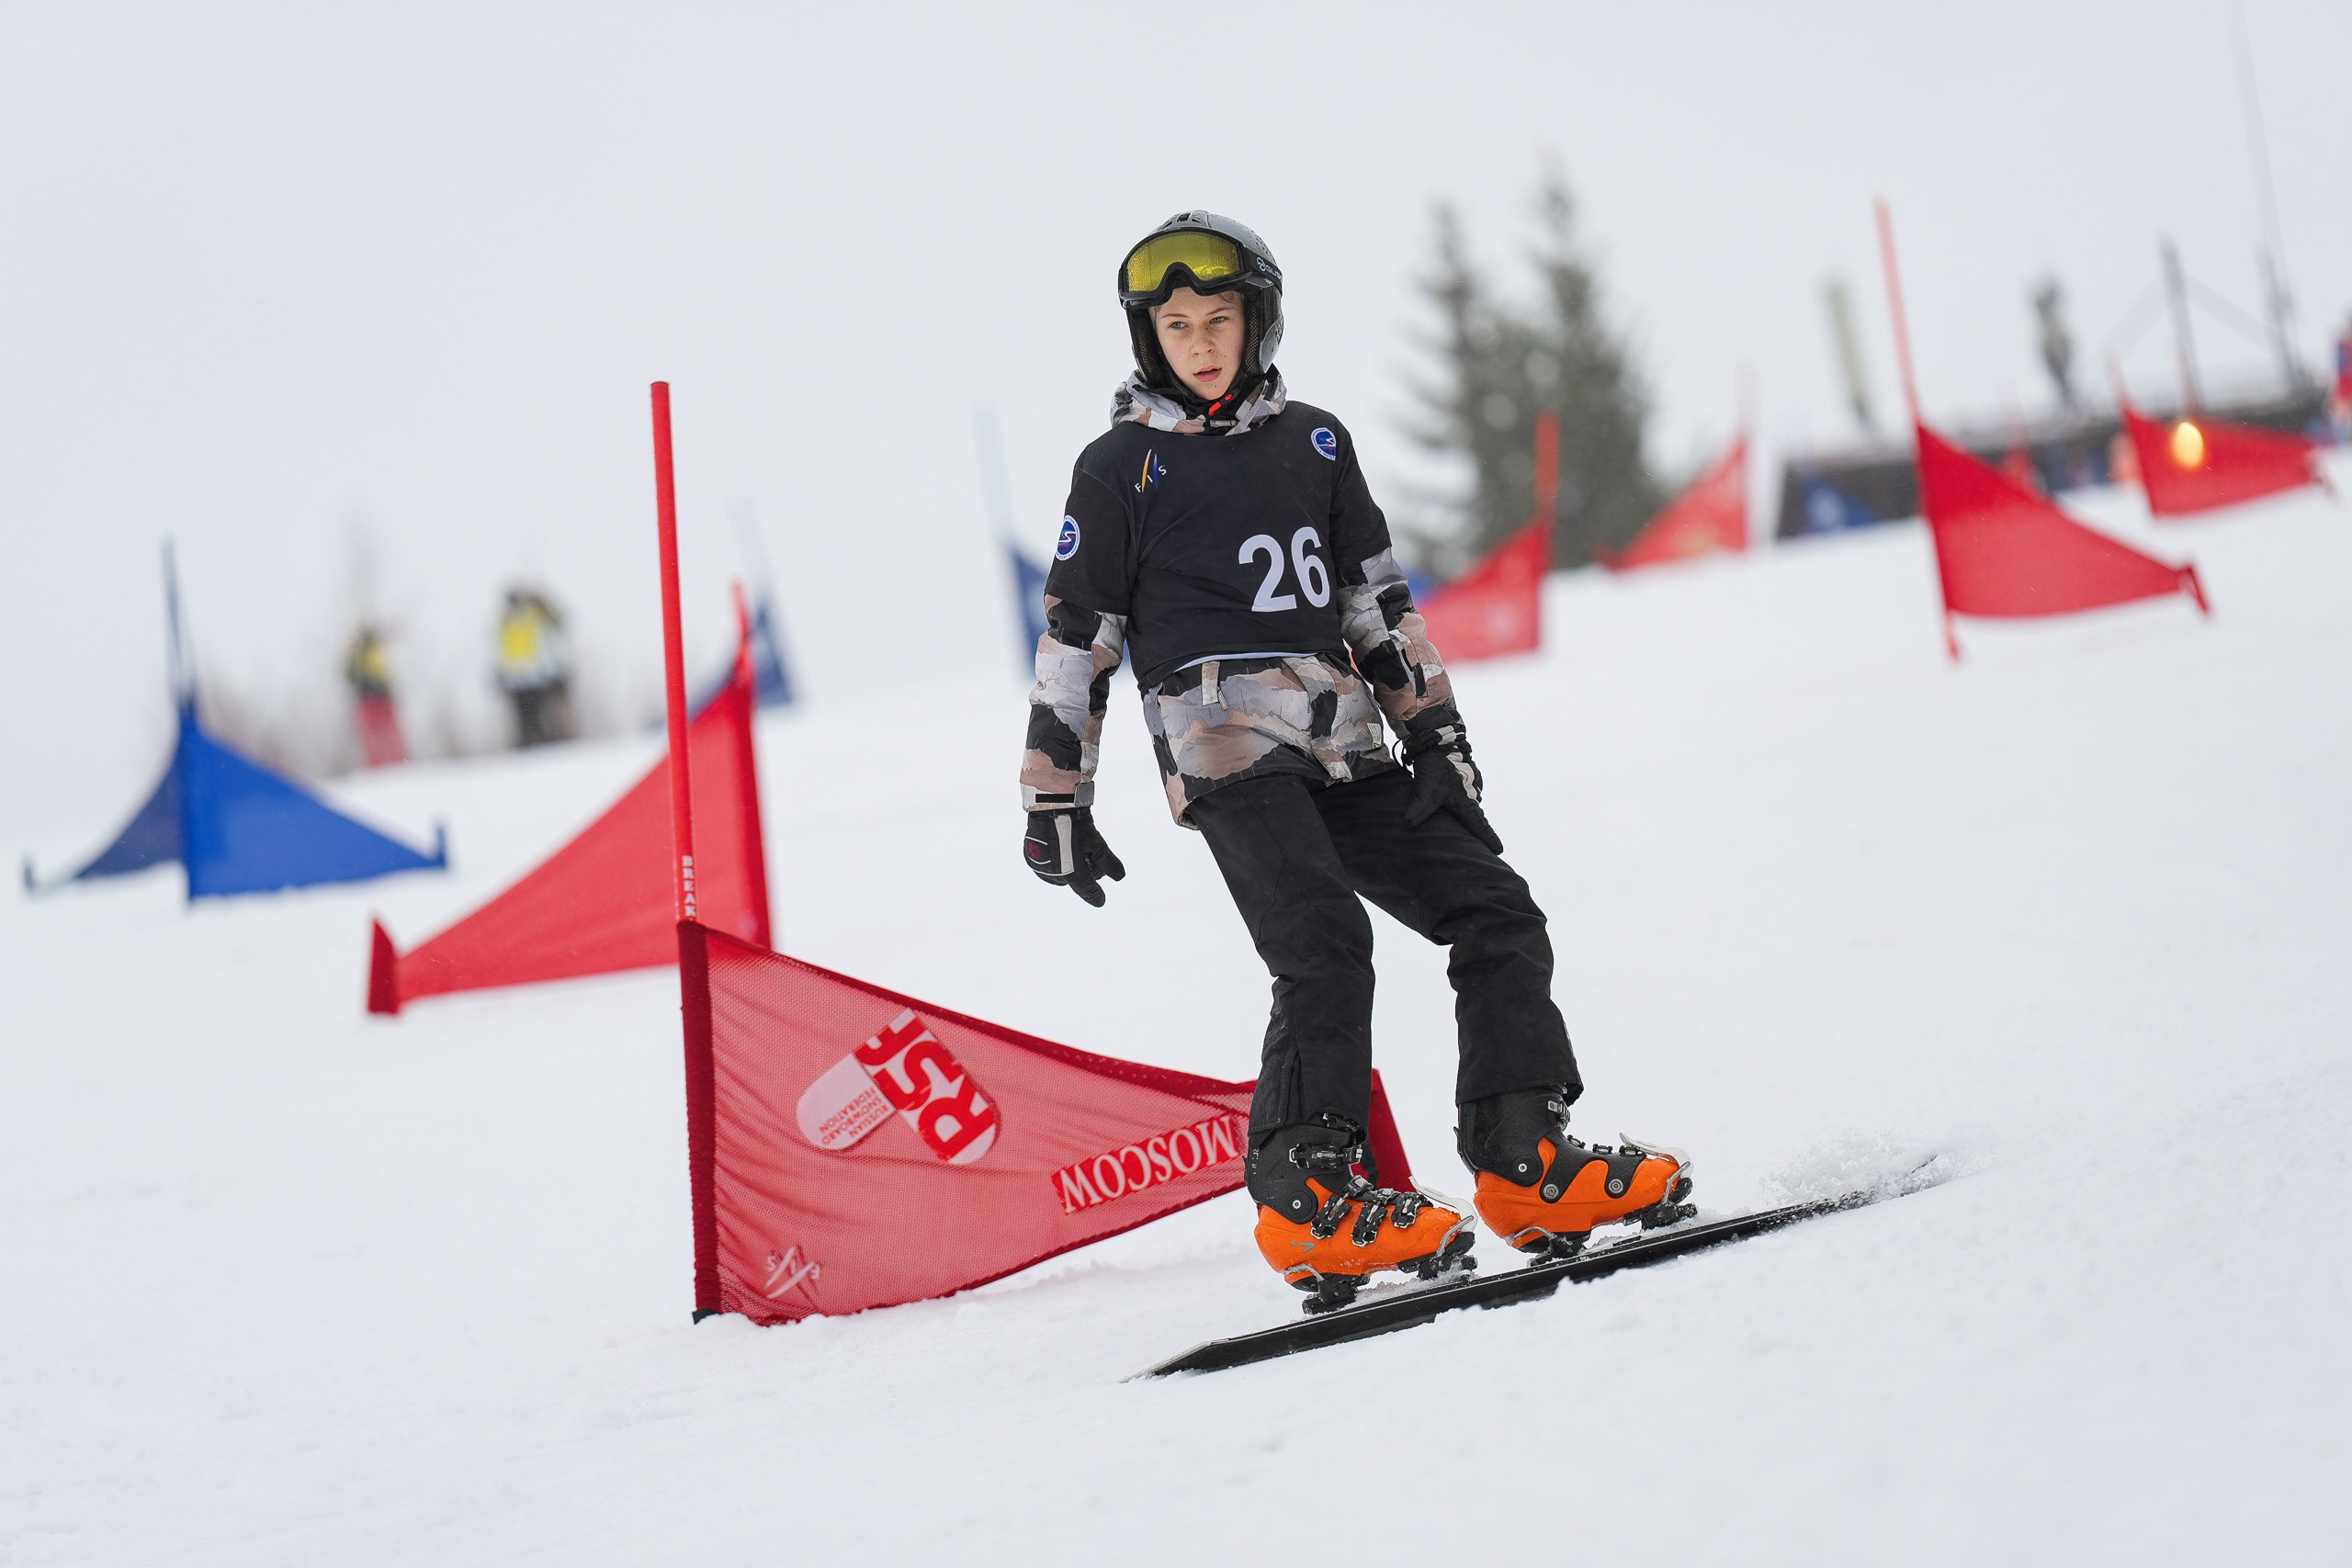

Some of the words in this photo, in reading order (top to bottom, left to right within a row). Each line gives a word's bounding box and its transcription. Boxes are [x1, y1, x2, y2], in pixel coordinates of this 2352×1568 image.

[1134, 464, 1167, 493] FIS
[1238, 525, 1330, 613] 26
[682, 855, 697, 921] BREAK
[820, 1087, 876, 1134] FEDERATION
[821, 1095, 883, 1145] SNOWBOARD
[848, 1104, 889, 1137] RUSSIAN
[1059, 1115, 1239, 1213] MOSCOW
